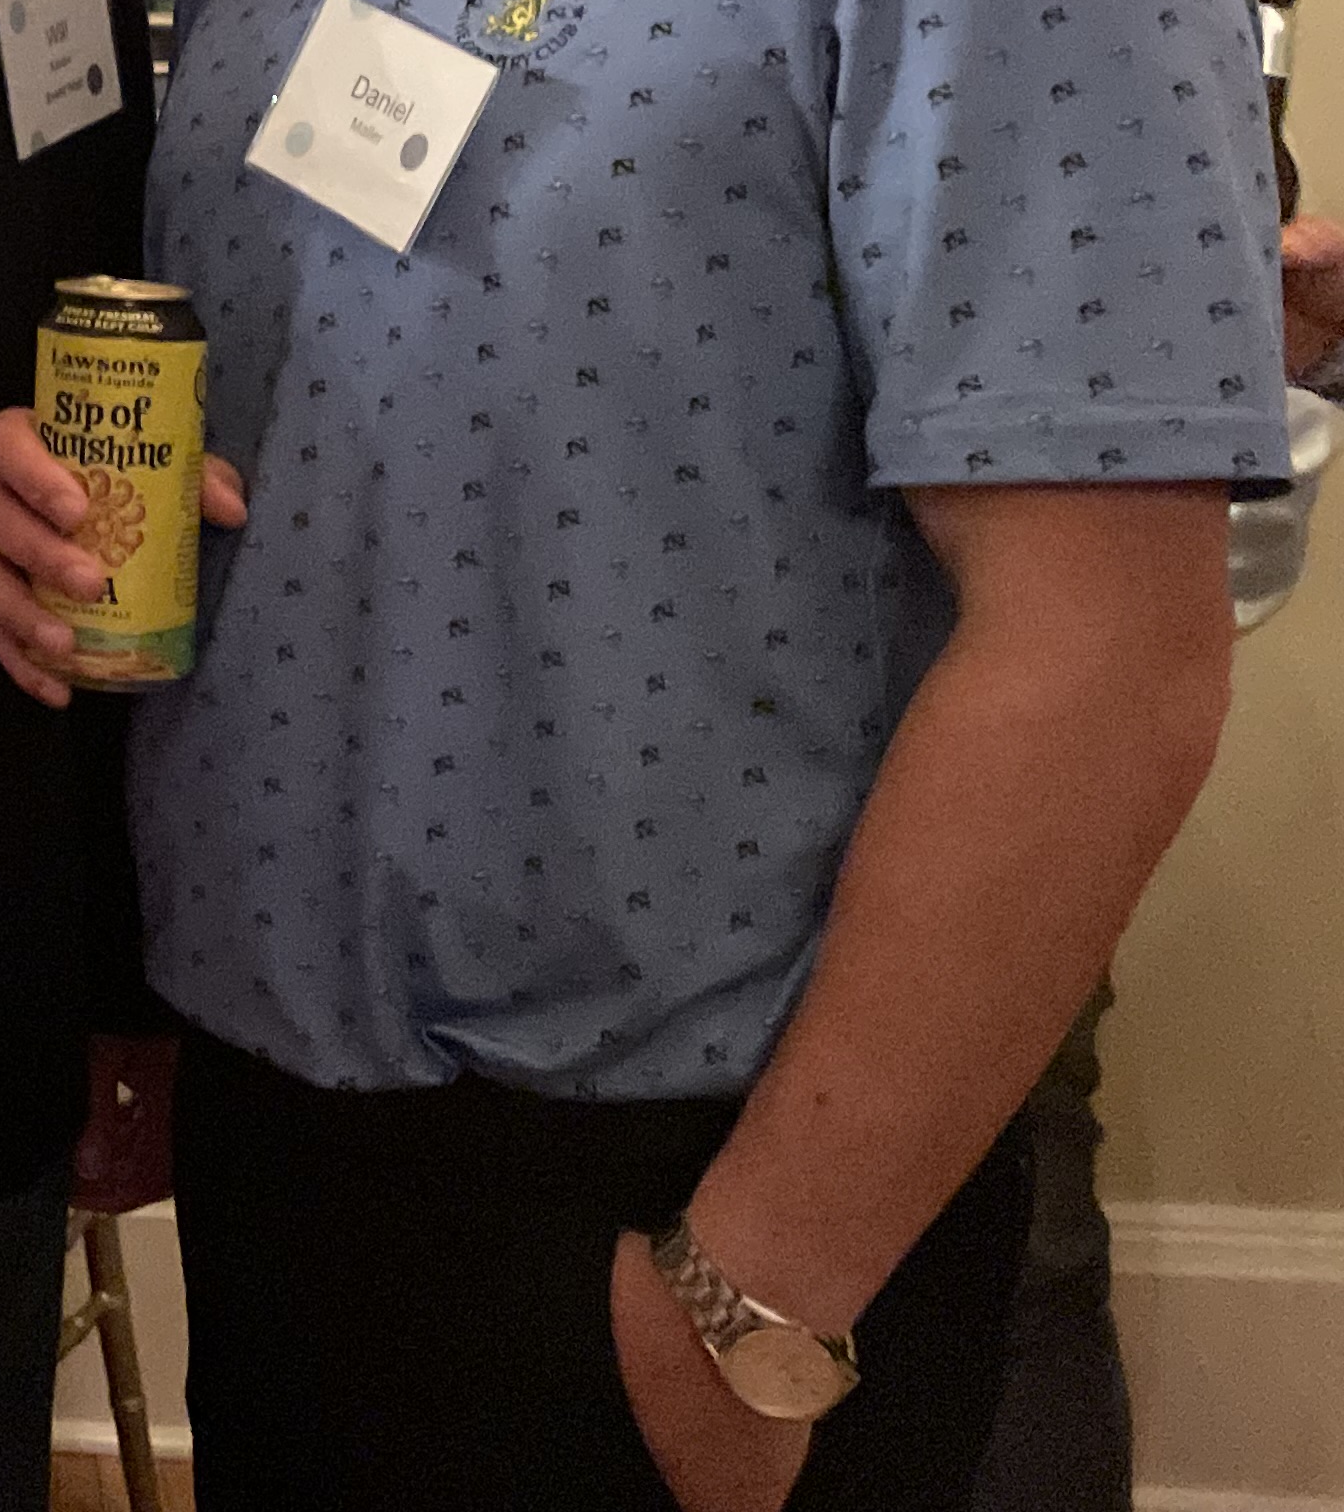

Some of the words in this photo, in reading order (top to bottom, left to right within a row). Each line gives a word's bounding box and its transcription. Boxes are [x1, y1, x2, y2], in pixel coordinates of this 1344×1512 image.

[535, 23, 578, 61] CLUB
[351, 74, 415, 125] Daniel
[54, 390, 104, 433] Sip
[111, 396, 152, 431] of
[39, 422, 173, 473] Sunshine
